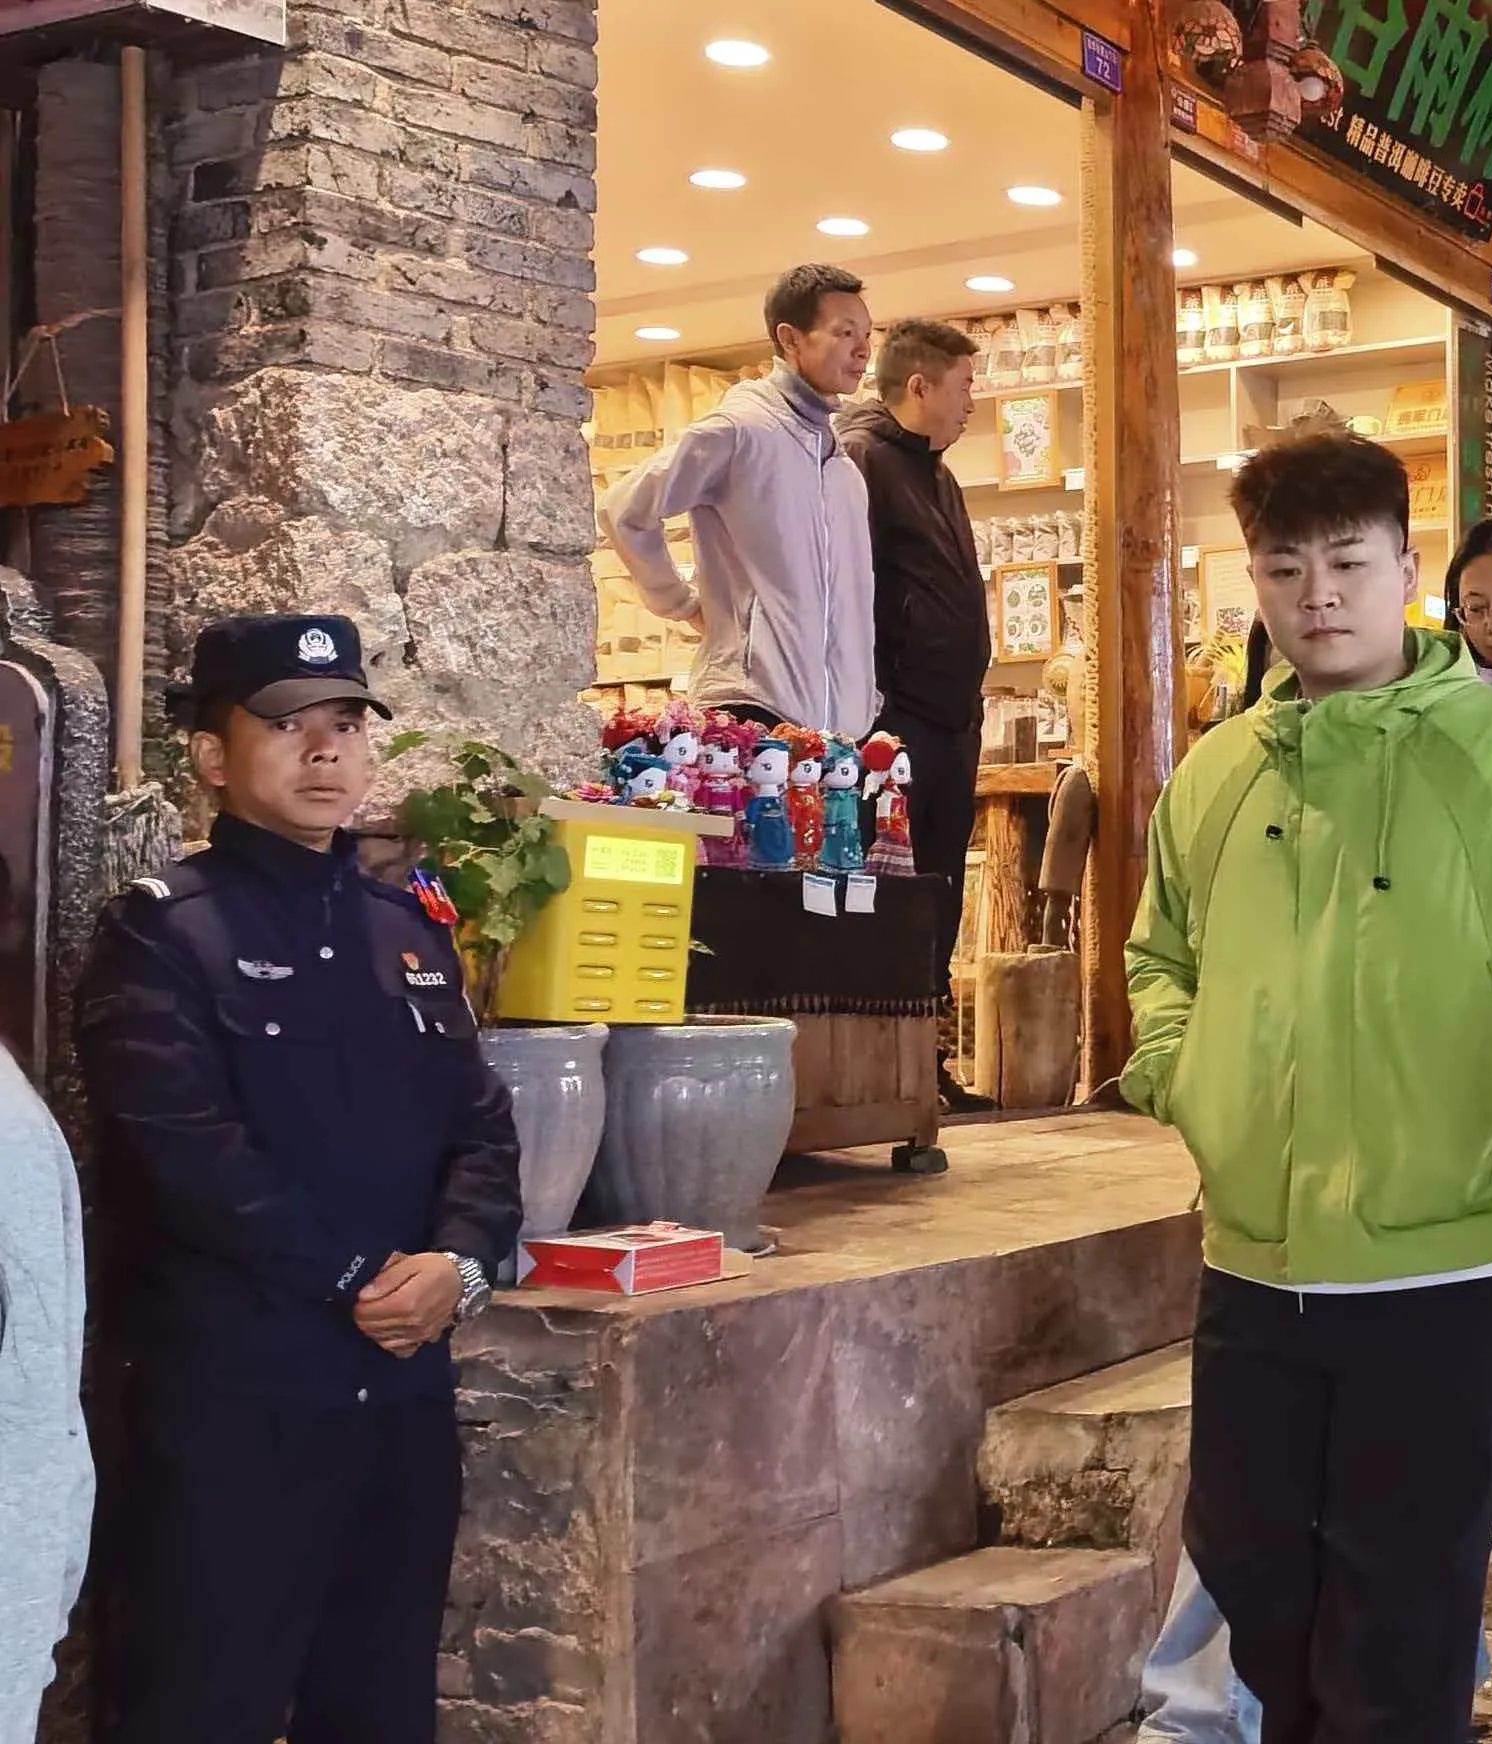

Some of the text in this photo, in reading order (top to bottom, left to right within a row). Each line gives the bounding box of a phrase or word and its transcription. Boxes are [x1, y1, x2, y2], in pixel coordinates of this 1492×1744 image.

[1096, 56, 1111, 80] 72
[1346, 112, 1469, 212] 精品普洱咖啡豆专卖
[336, 1254, 367, 1290] POLICE
